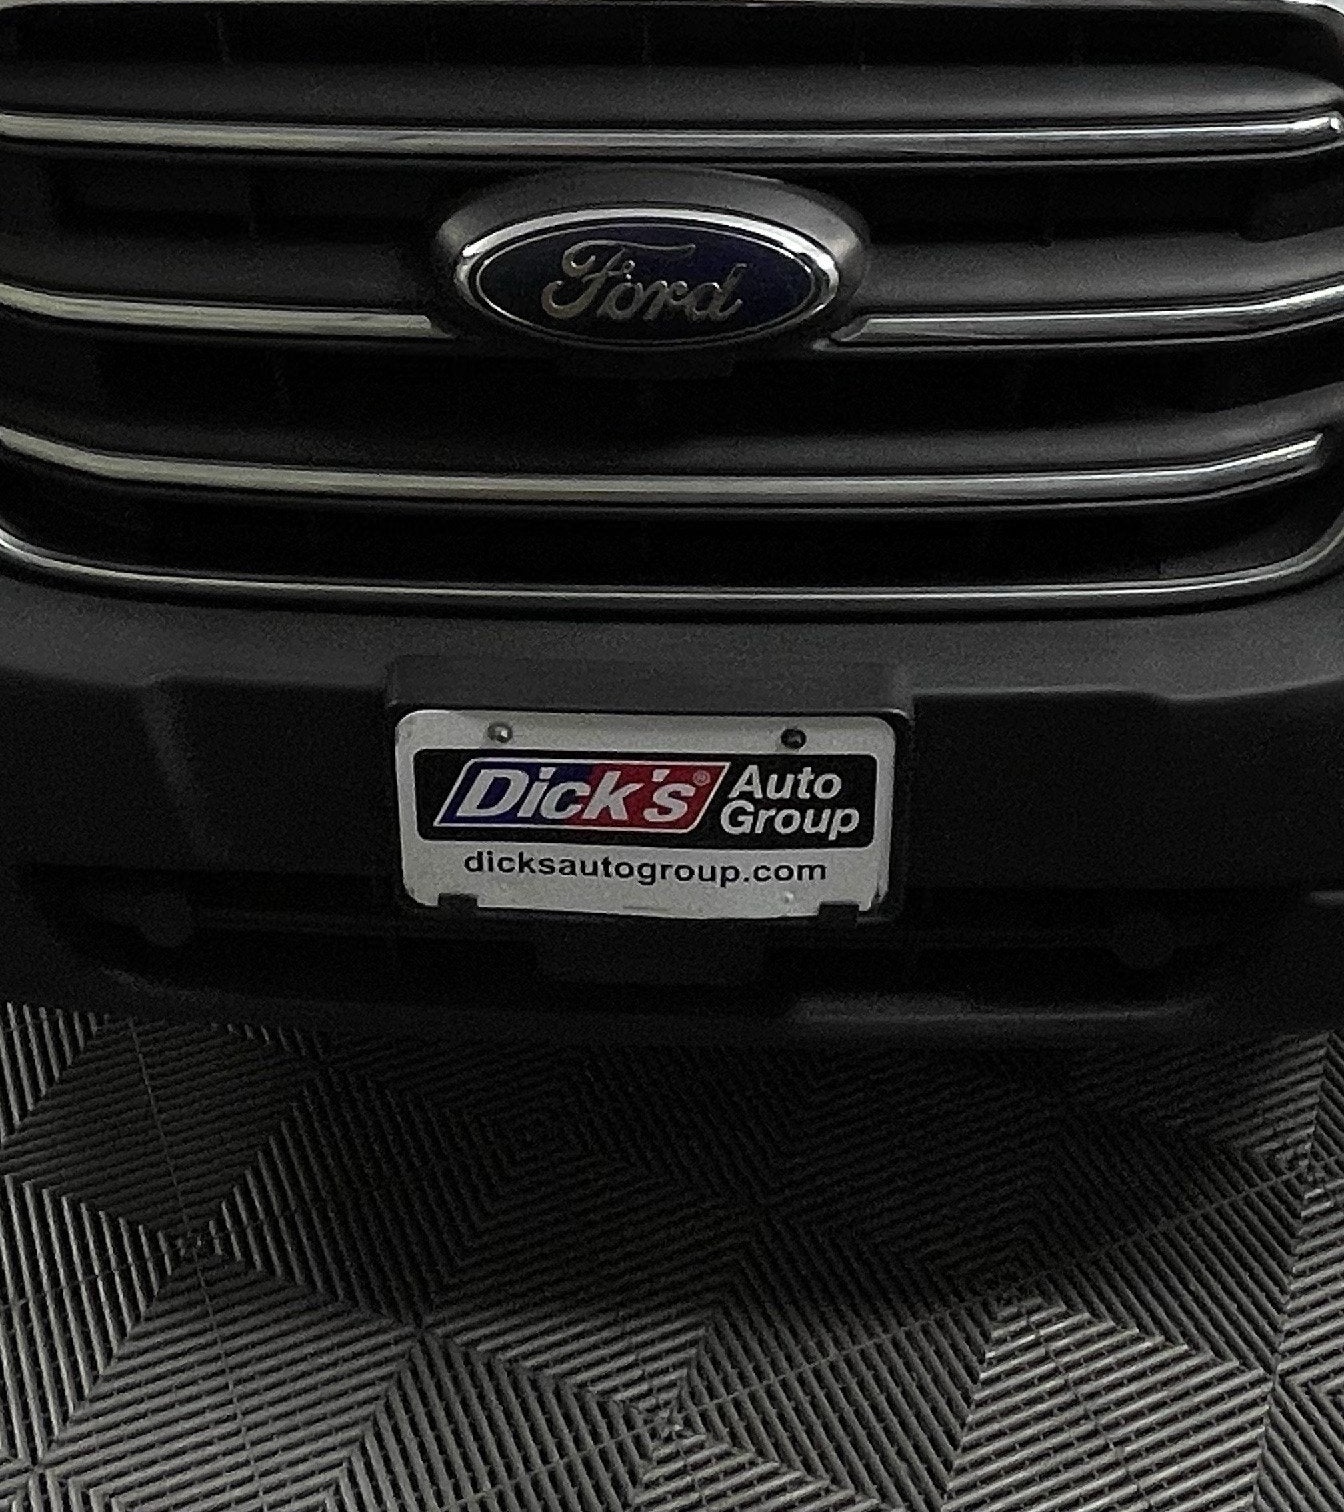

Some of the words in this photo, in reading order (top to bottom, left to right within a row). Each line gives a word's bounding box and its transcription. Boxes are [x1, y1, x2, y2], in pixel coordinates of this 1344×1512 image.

[541, 240, 748, 322] Ford
[457, 767, 693, 822] Dick's
[728, 765, 843, 800] Auto
[720, 801, 860, 840] Group
[464, 852, 828, 887] dicksautogroup.com
